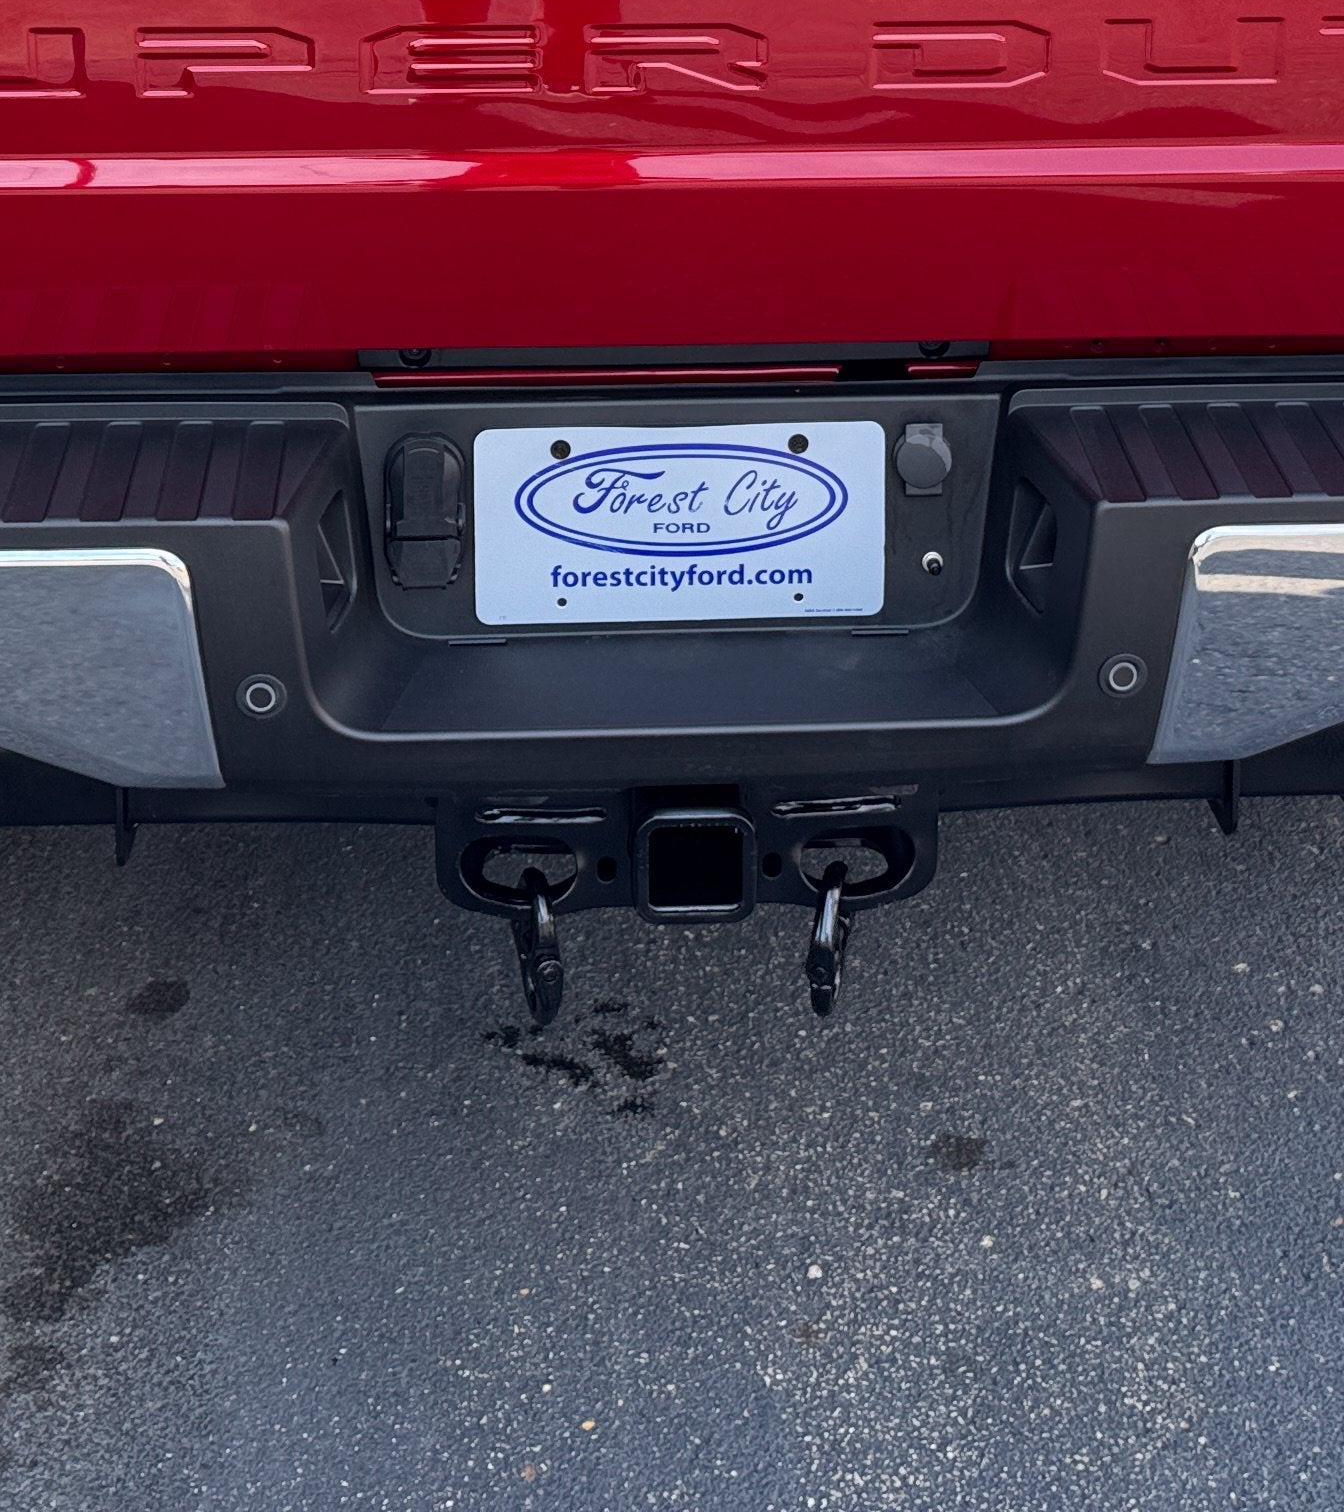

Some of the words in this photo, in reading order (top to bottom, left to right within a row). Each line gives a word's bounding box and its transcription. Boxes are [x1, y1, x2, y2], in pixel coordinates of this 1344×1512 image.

[572, 467, 709, 516] Forest
[723, 469, 799, 531] City
[652, 522, 711, 535] FORD
[550, 563, 813, 593] forestcityford.com
